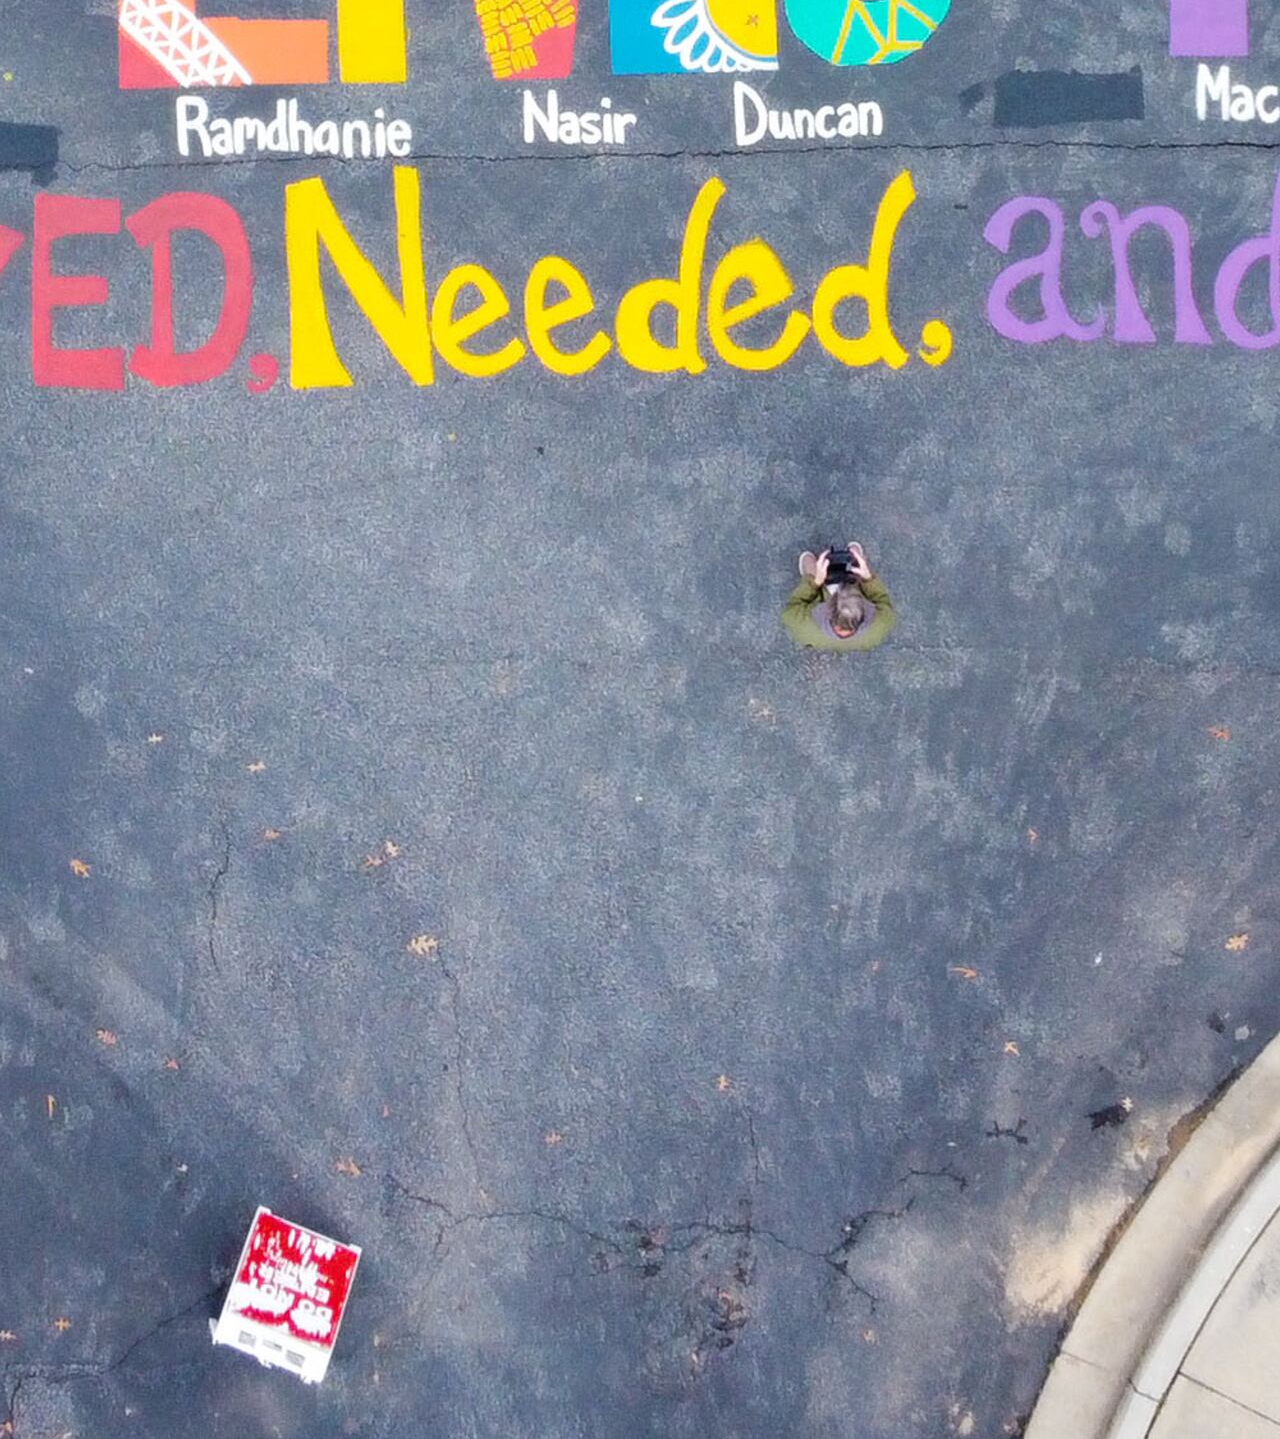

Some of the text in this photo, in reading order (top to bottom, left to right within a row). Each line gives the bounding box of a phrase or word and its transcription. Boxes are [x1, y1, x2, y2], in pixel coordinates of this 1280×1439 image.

[177, 96, 412, 158] Ramdhanie
[524, 90, 636, 144] Nasir
[734, 81, 882, 145] Duncan
[285, 165, 953, 390] Needed,
